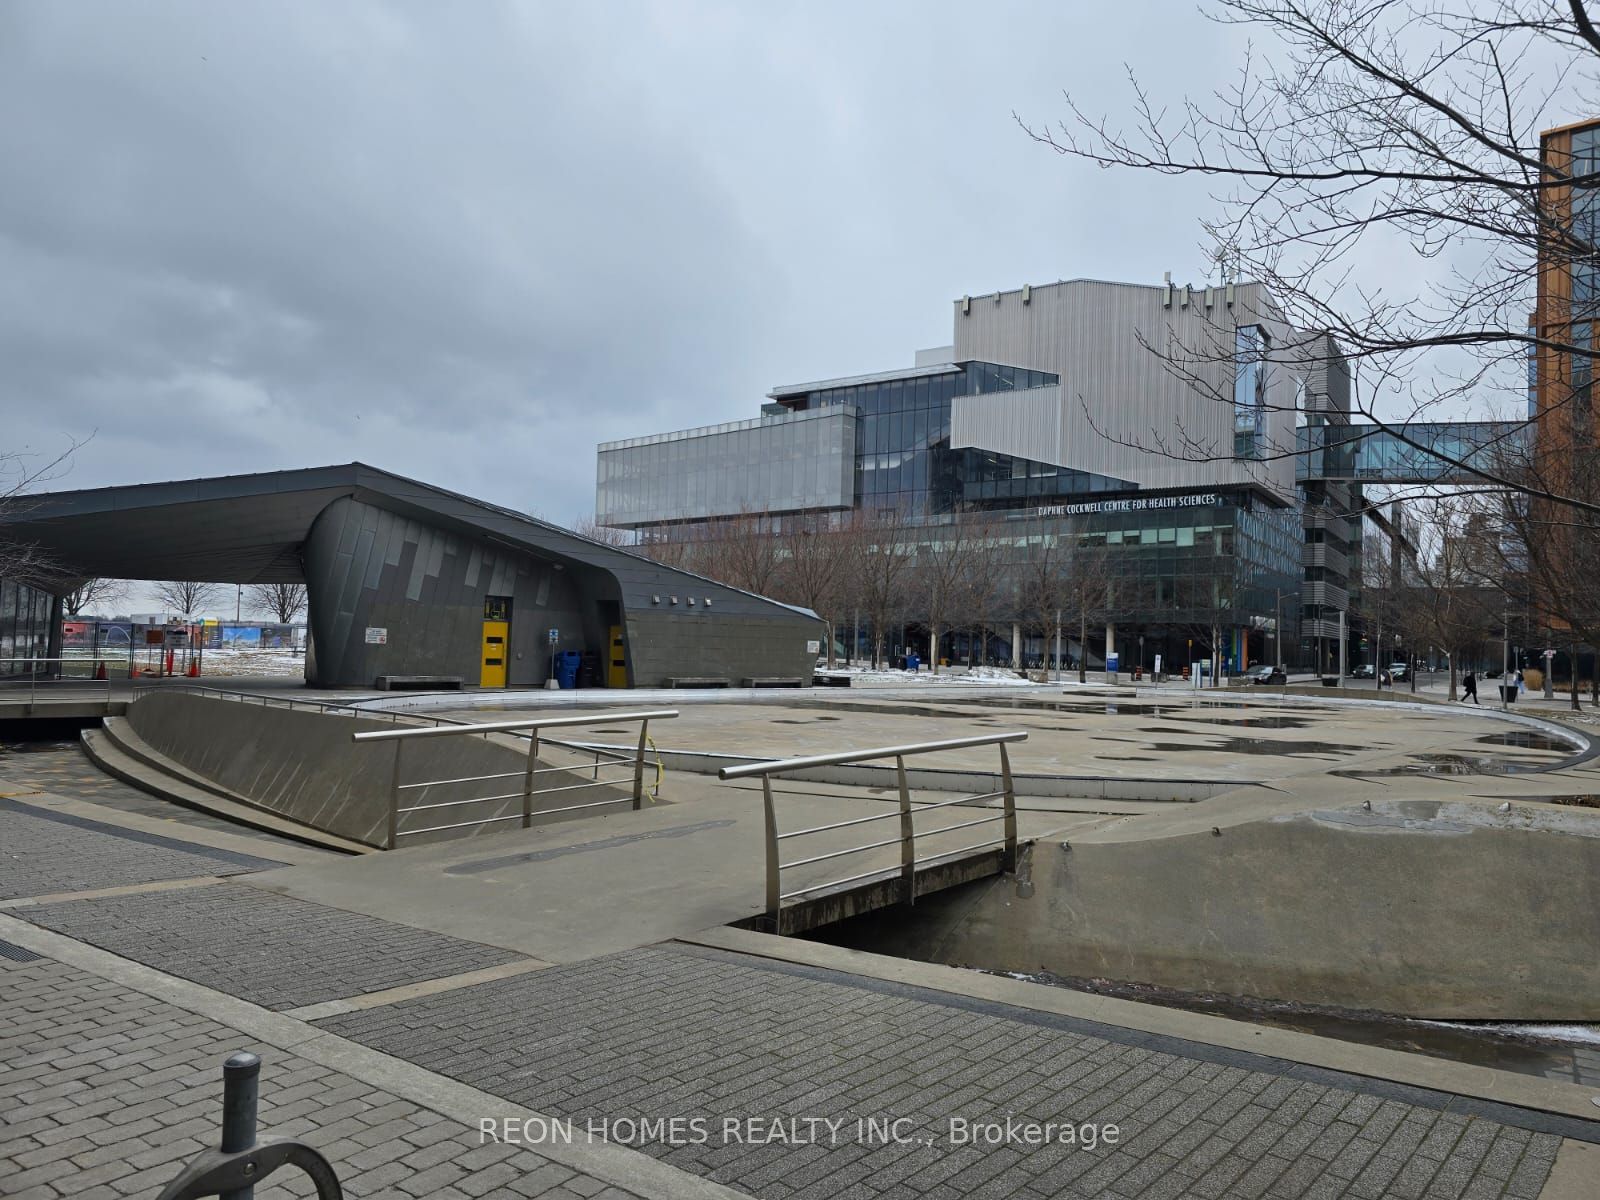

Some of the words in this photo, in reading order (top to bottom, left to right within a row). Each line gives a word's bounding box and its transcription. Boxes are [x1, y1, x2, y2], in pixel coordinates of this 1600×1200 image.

[1038, 505, 1065, 516] DAPHNE
[1066, 502, 1101, 514] COCKWELL
[1104, 499, 1131, 511] CENTRE
[1132, 499, 1147, 510] FOR
[1149, 496, 1177, 509] HEALTH
[1179, 494, 1215, 507] SCIENCES
